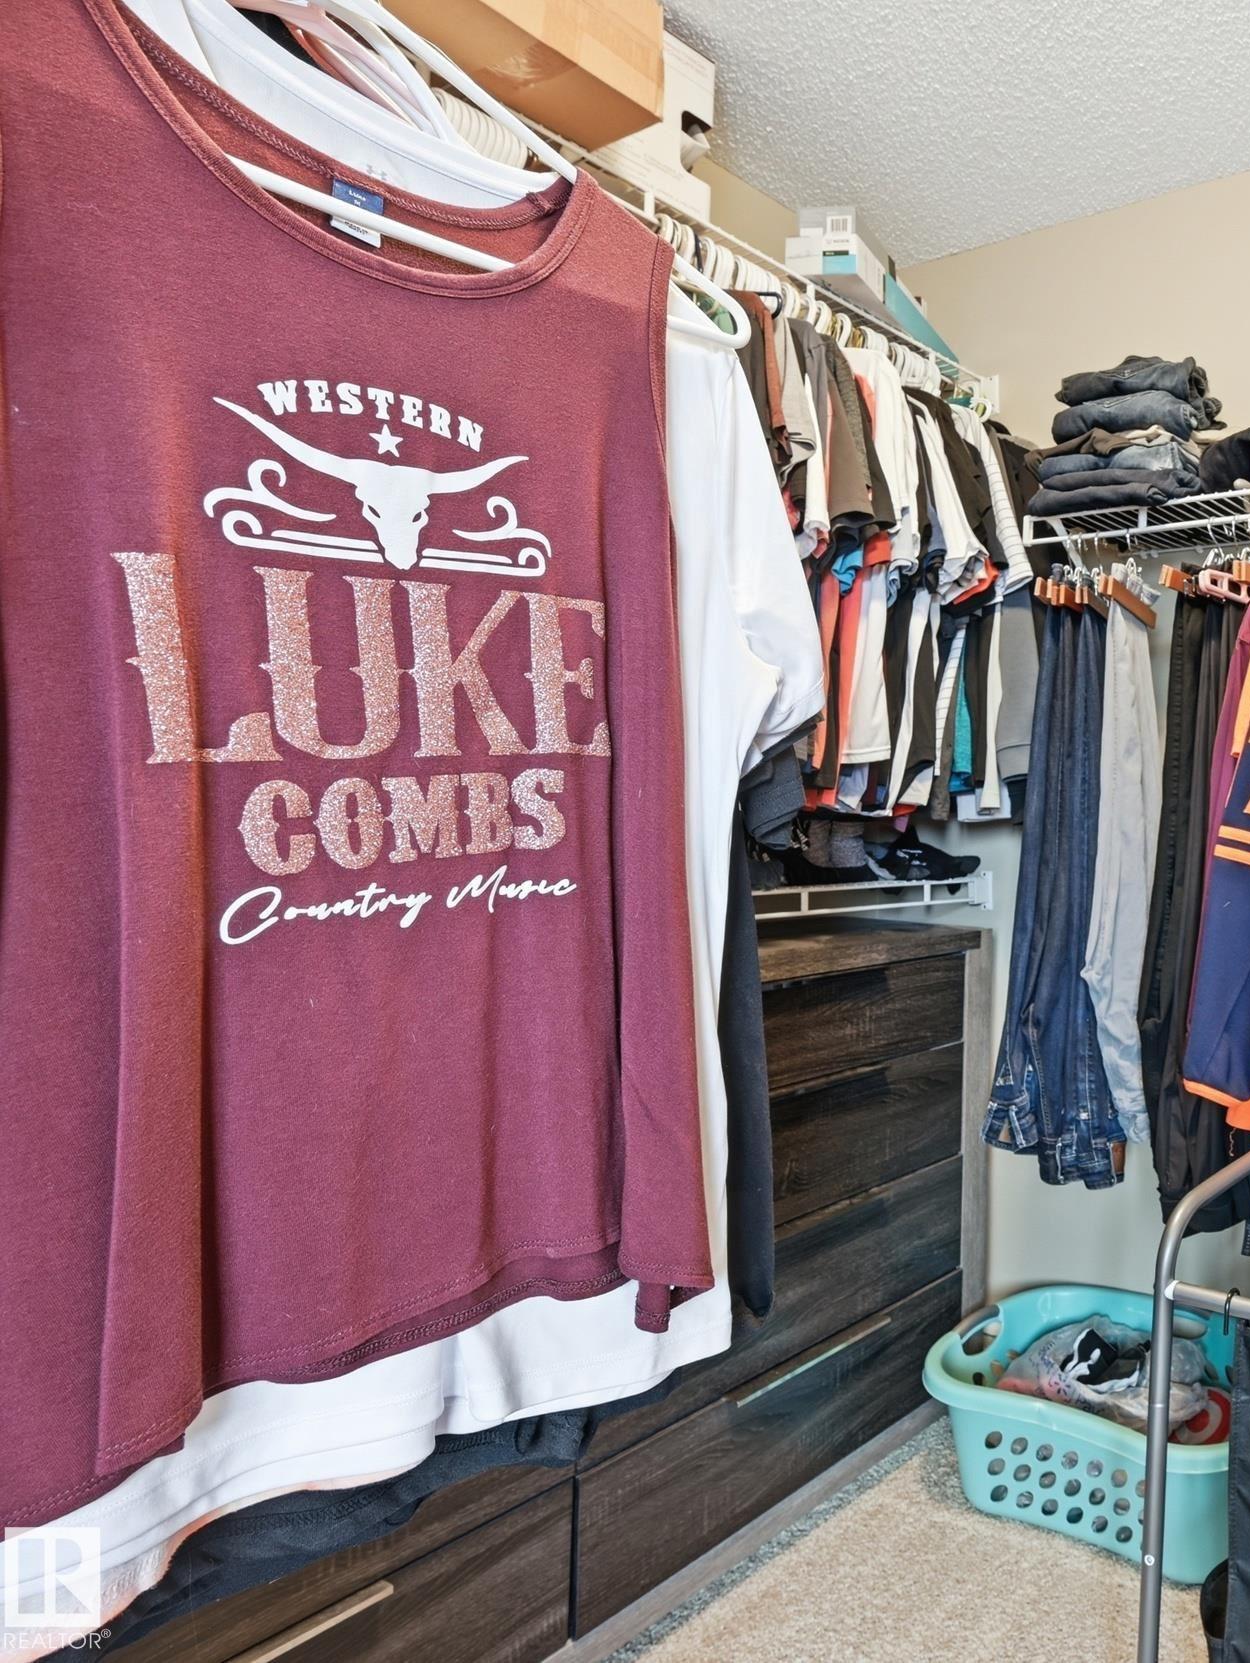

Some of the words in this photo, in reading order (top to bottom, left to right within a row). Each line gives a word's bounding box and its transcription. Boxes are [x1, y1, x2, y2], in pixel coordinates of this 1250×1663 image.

[258, 379, 485, 452] WESTERN
[110, 551, 611, 764] LUKE
[237, 768, 564, 876] COMBS
[219, 882, 432, 945] Country
[446, 865, 577, 913] Music
